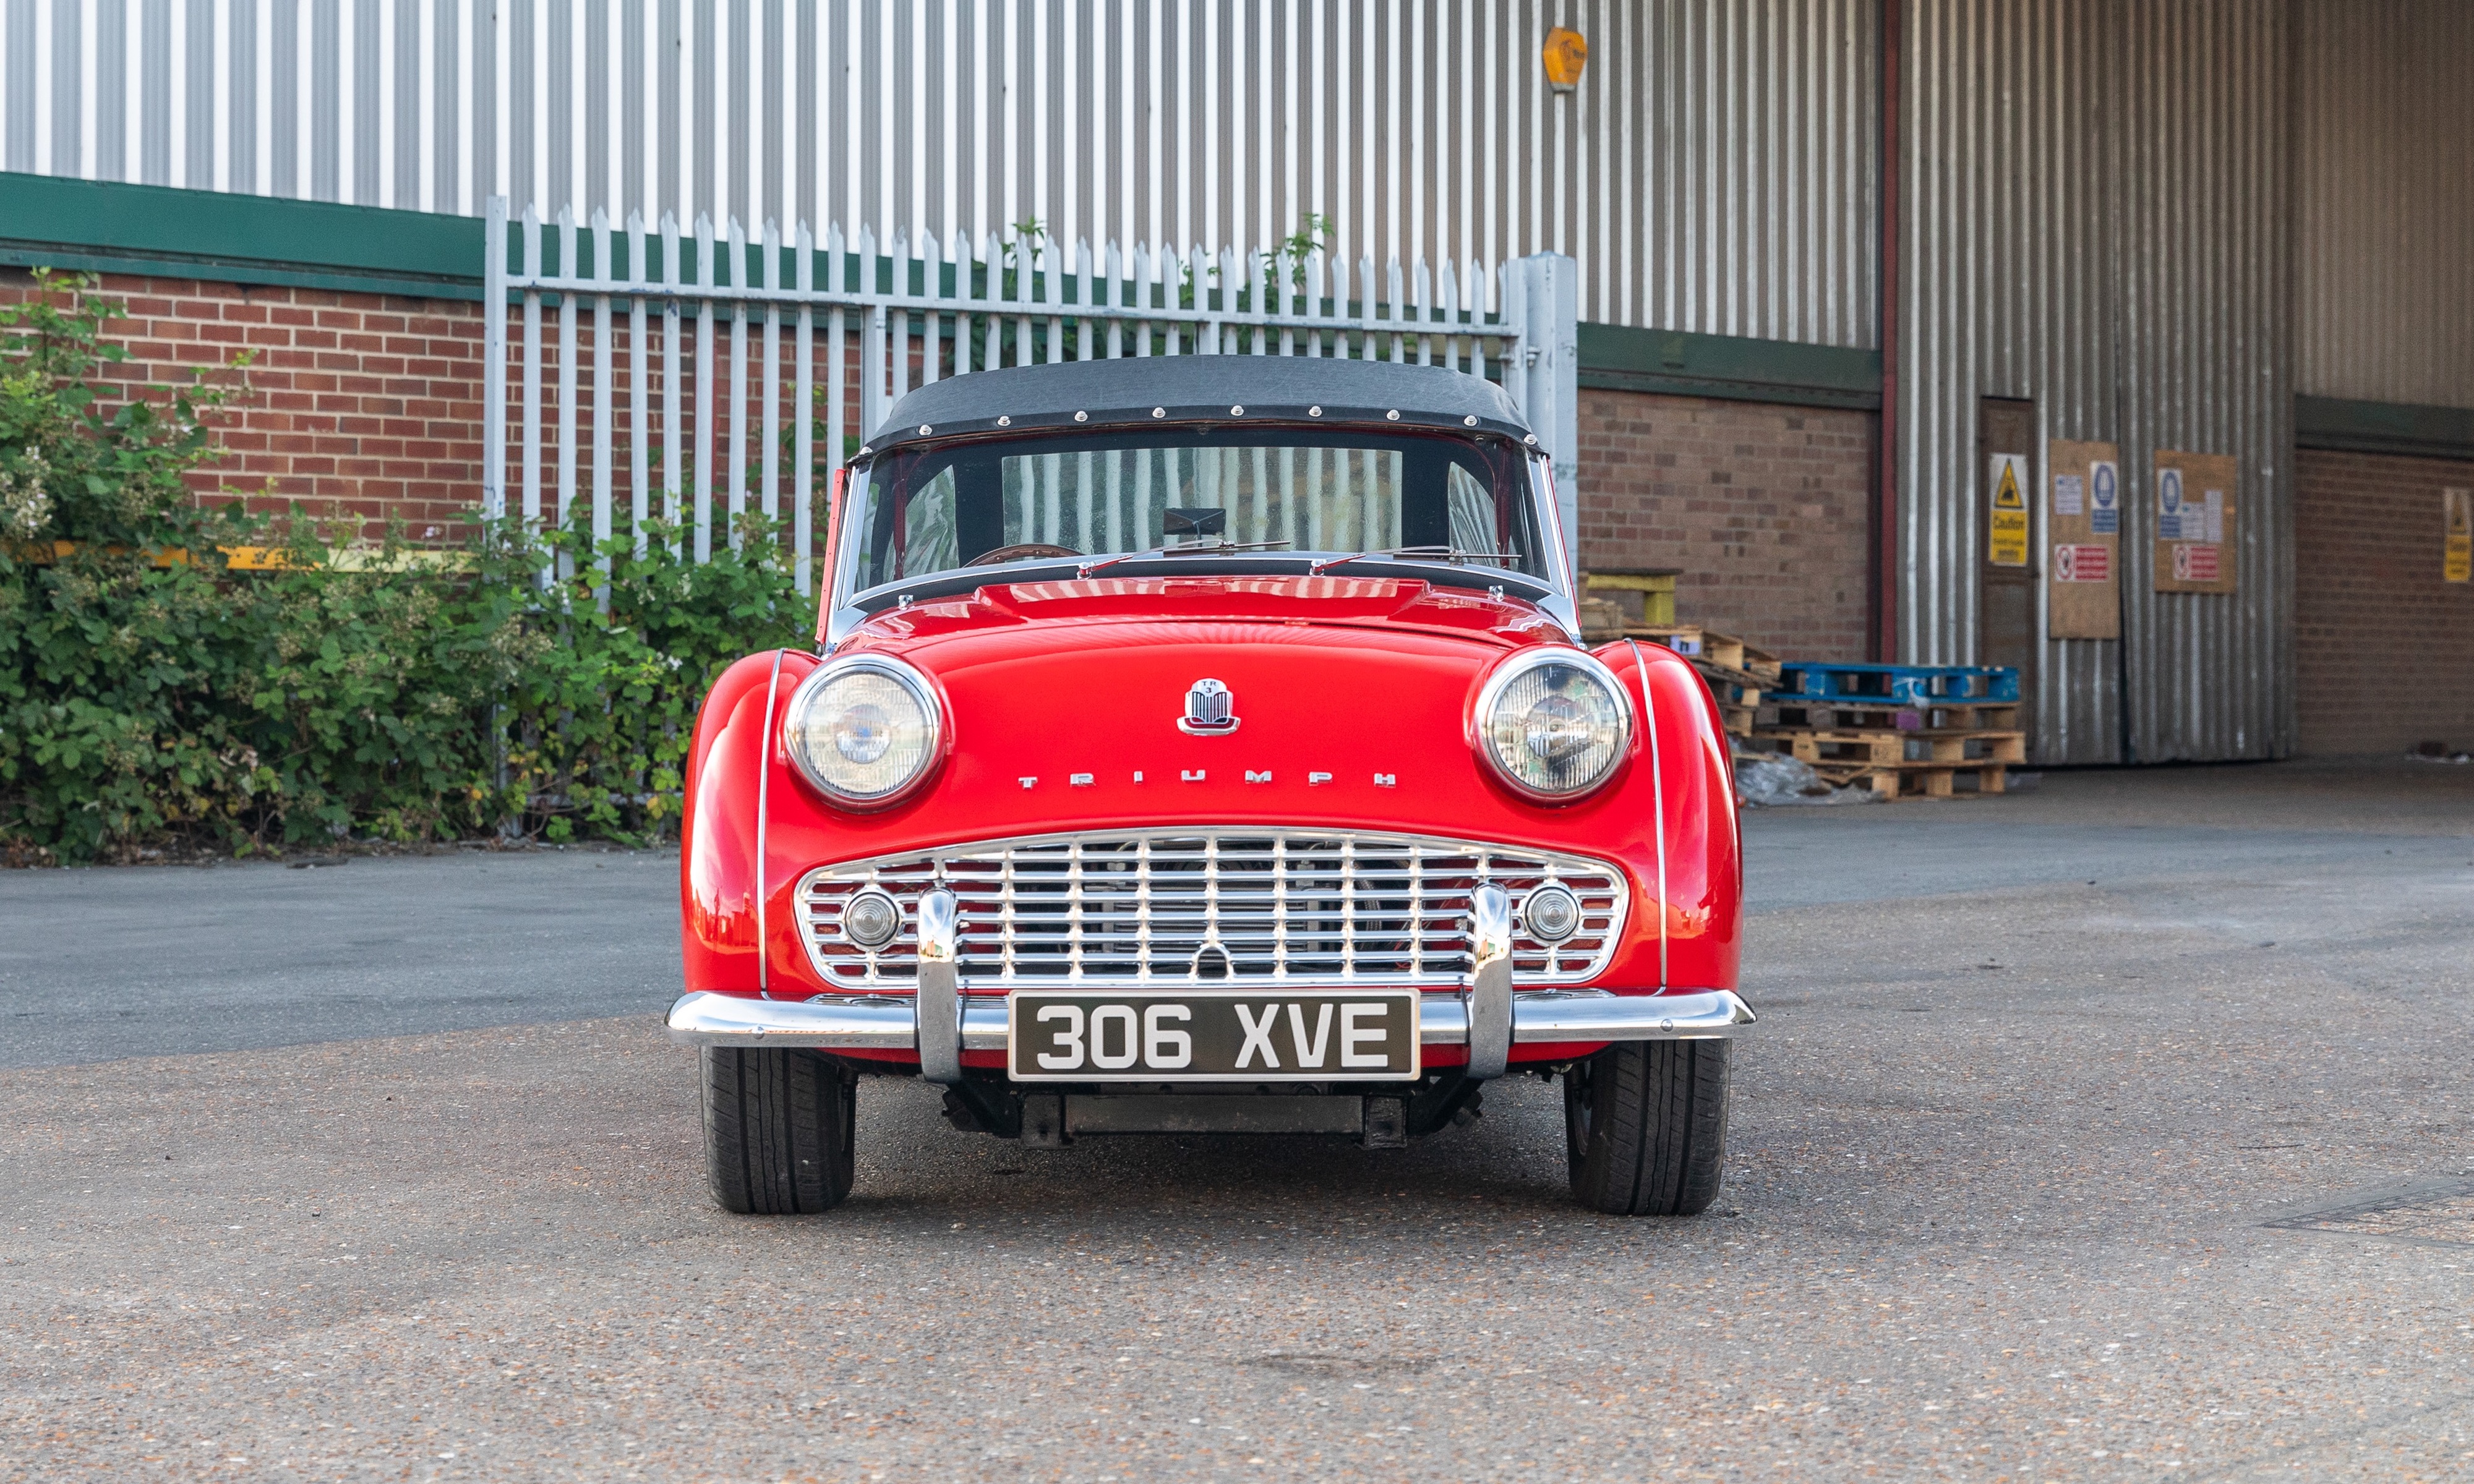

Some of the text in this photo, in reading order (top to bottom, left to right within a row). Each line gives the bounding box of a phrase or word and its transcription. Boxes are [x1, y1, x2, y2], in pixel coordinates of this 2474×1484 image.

[1017, 769, 1397, 788] TRIUMPH
[1037, 1003, 1388, 1069] 306 XVE
